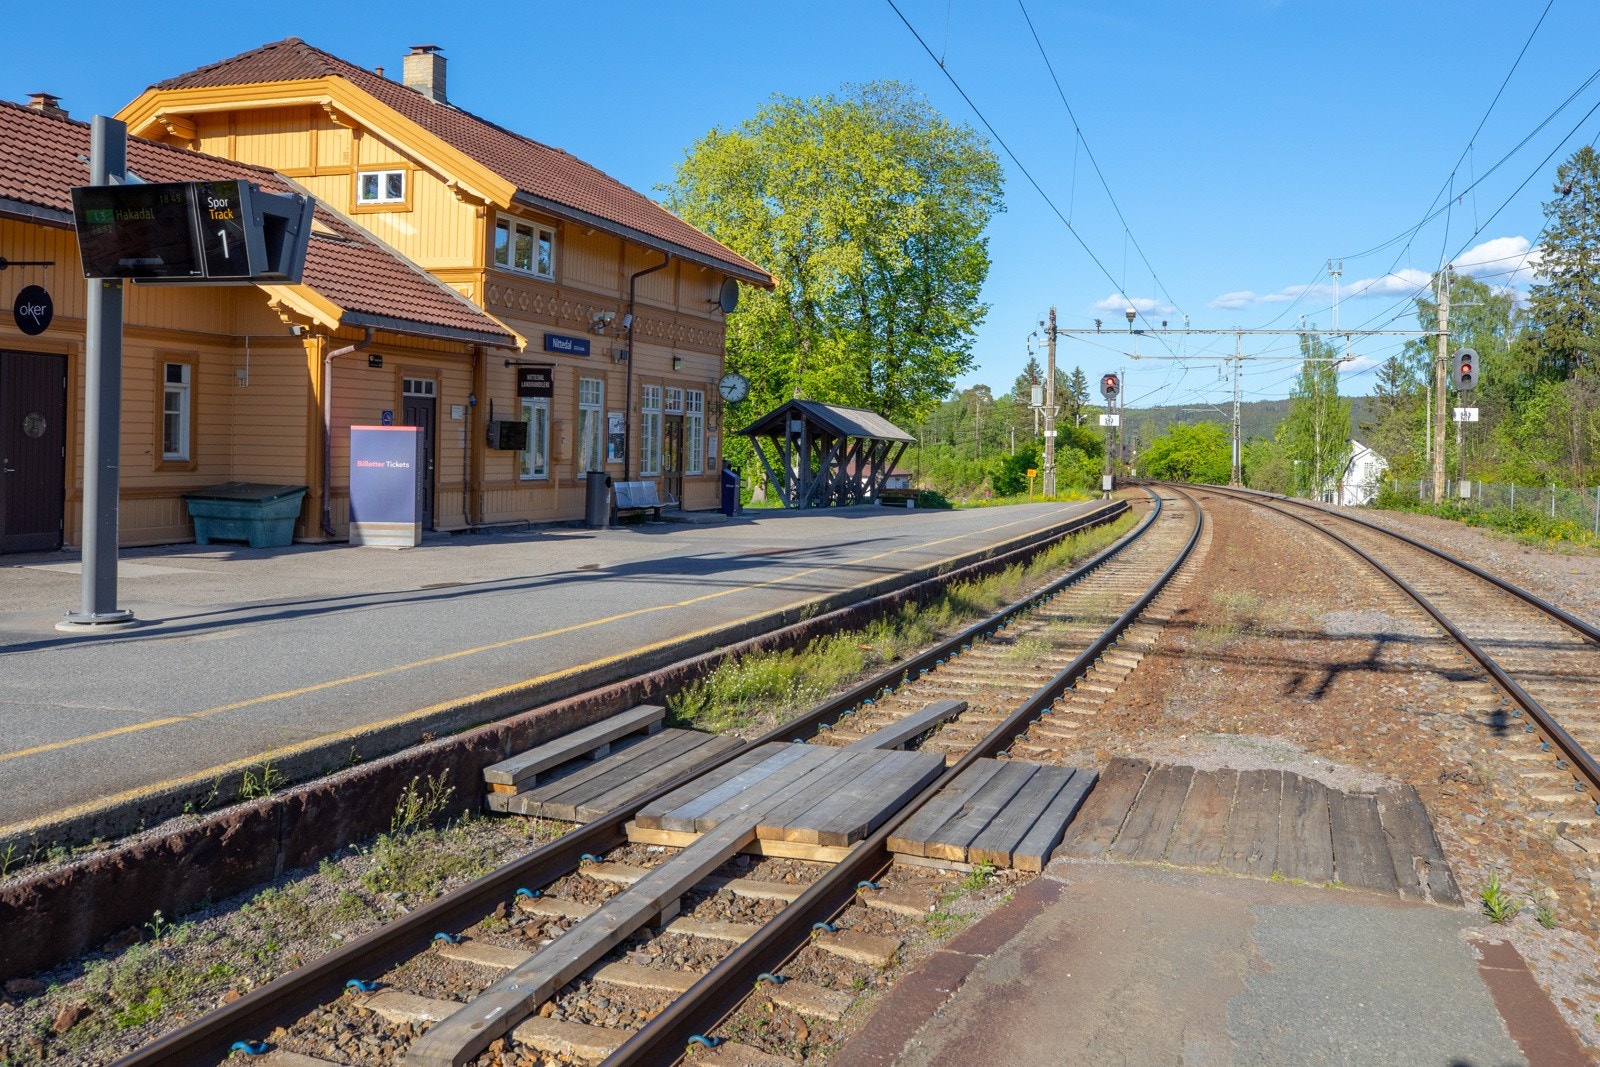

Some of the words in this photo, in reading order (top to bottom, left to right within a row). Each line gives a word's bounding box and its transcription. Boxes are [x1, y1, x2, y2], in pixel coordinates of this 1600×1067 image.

[207, 197, 229, 209] Spor
[116, 208, 155, 220] Hakadal
[208, 208, 234, 220] Track
[217, 229, 230, 259] 1
[19, 301, 47, 326] oker
[552, 338, 572, 350] Nittedal
[357, 460, 385, 468] Billetter
[386, 460, 410, 468] Tickets
